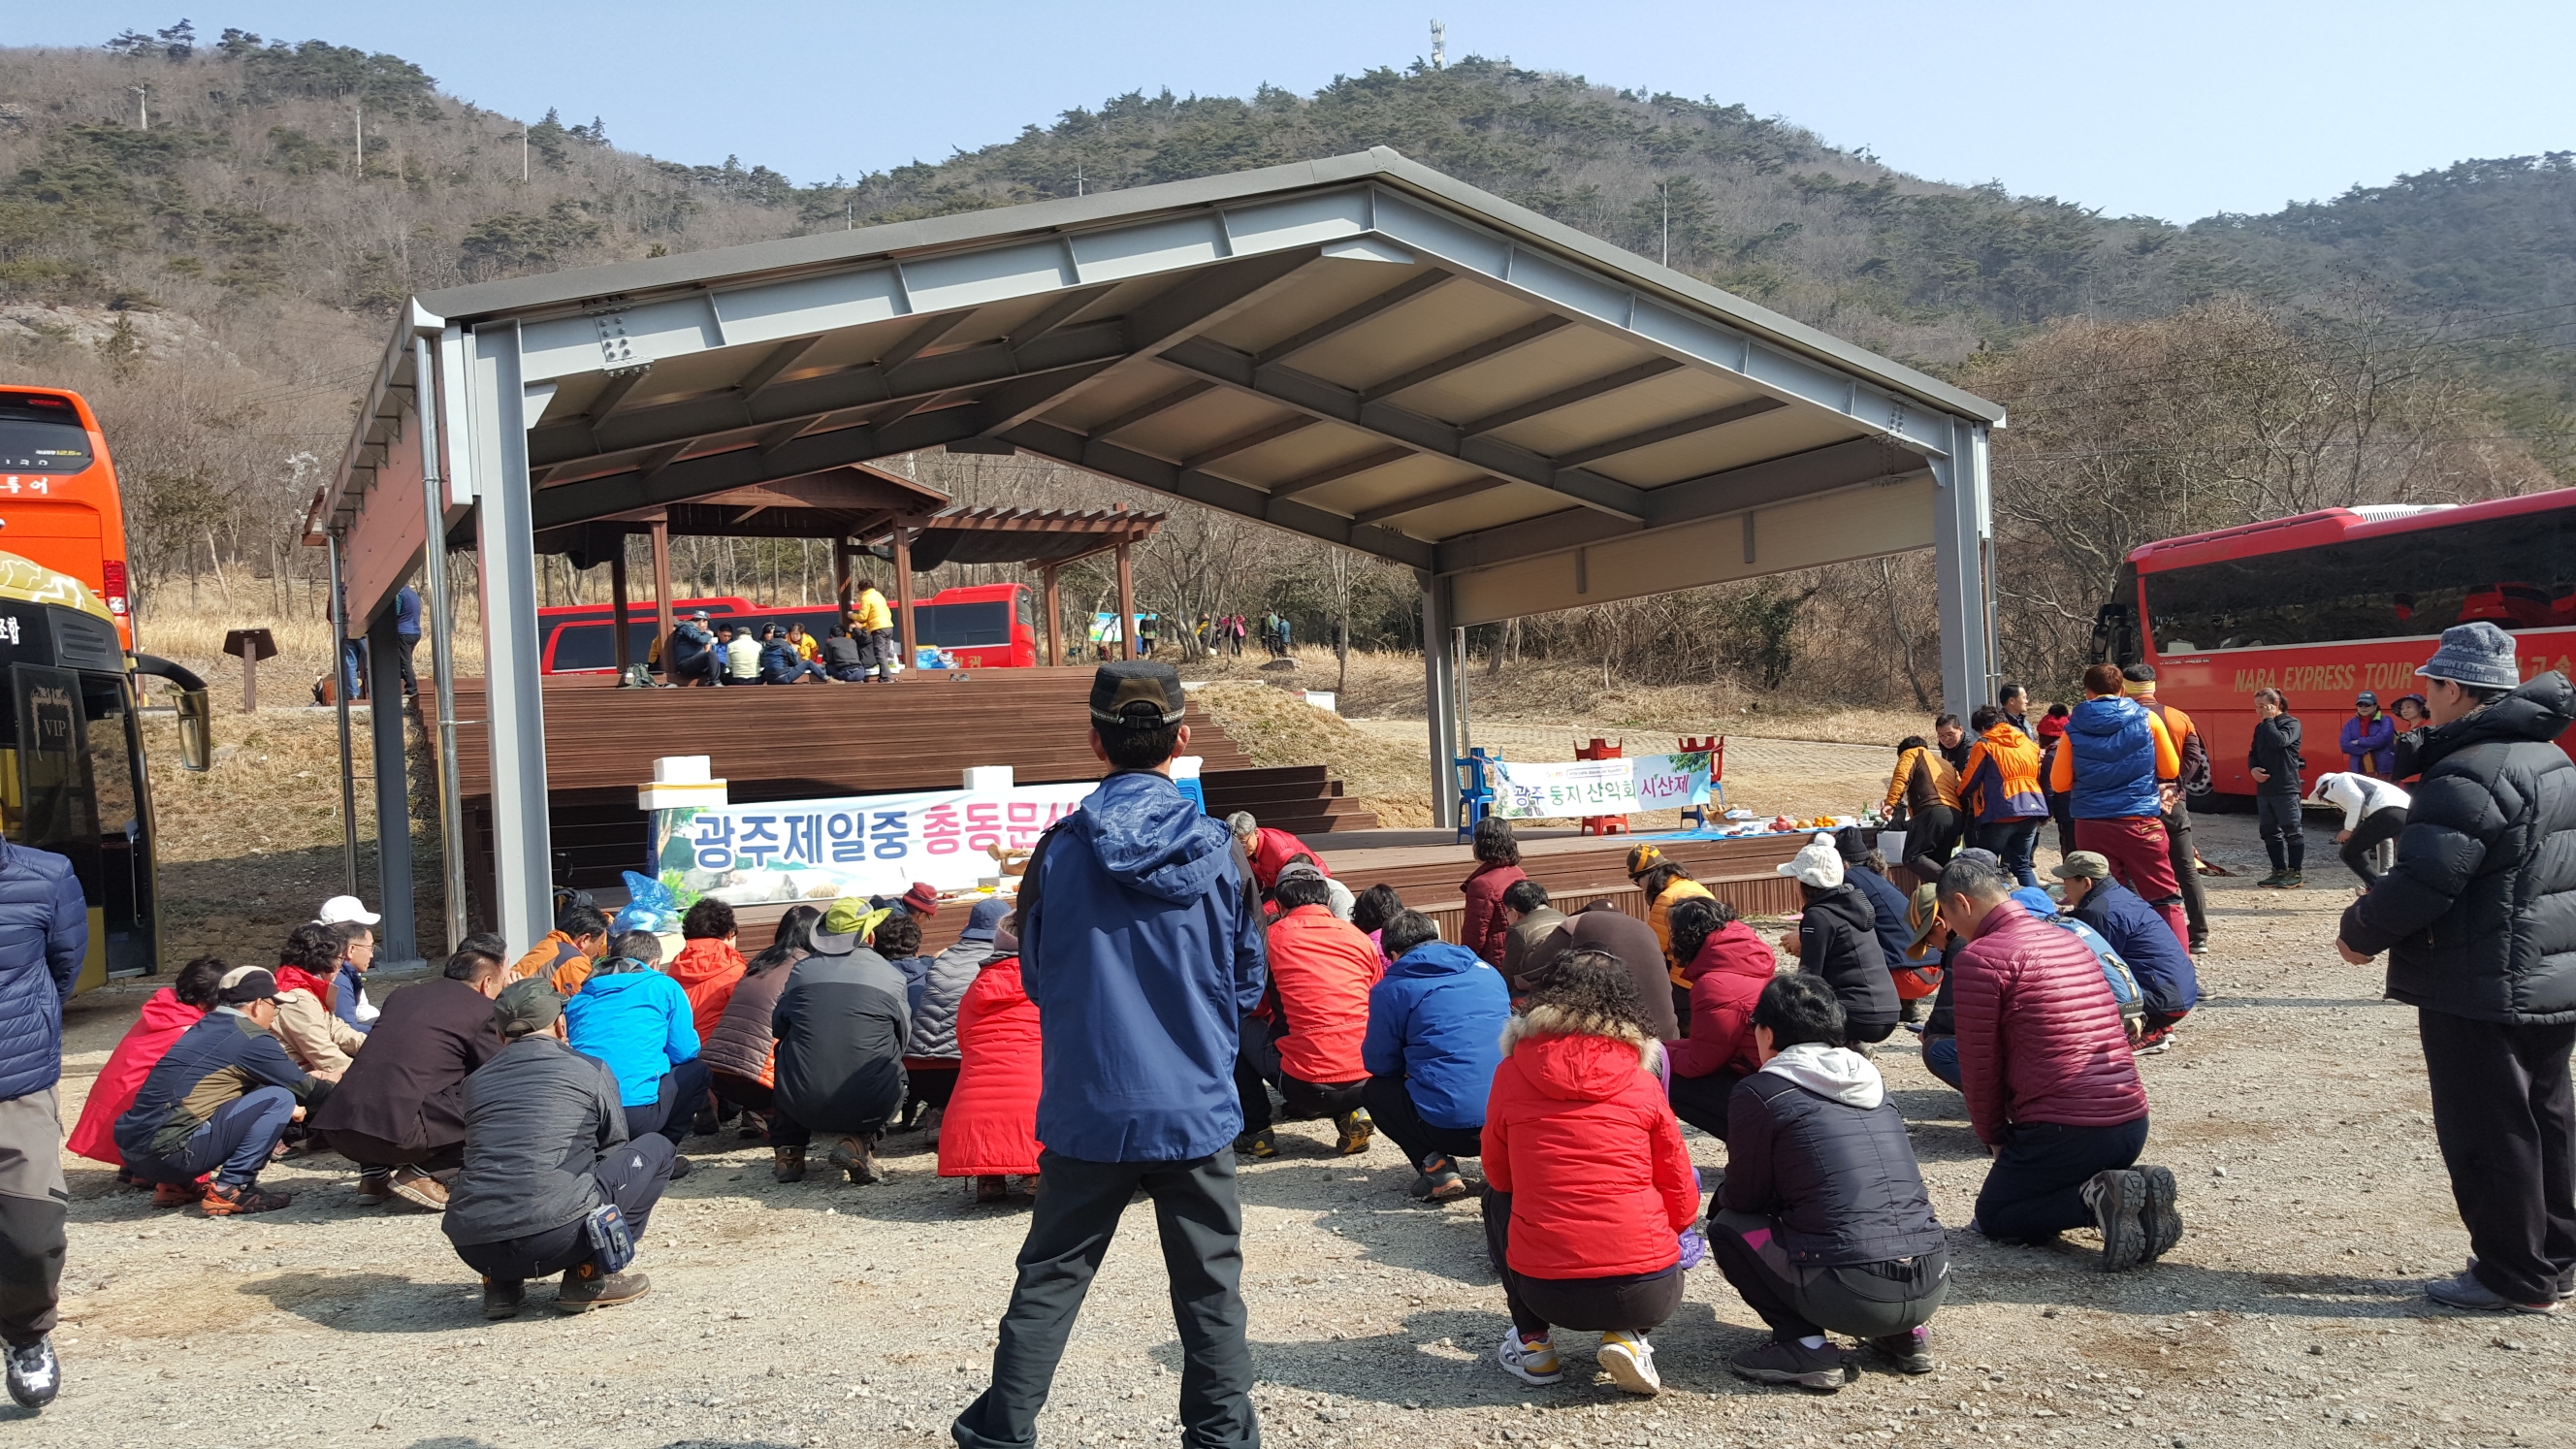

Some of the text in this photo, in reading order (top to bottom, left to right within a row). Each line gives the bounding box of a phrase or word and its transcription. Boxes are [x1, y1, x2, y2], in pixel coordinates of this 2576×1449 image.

[2234, 661, 2415, 693] NARA EXPRESS TOUR
[2431, 659, 2486, 673] MOUNTAIN
[2441, 667, 2498, 684] RESEARCH
[44, 719, 66, 737] VIP
[1514, 773, 1690, 807] 광주 둥지 산악회 시산제
[694, 811, 910, 868] 광주제일중
